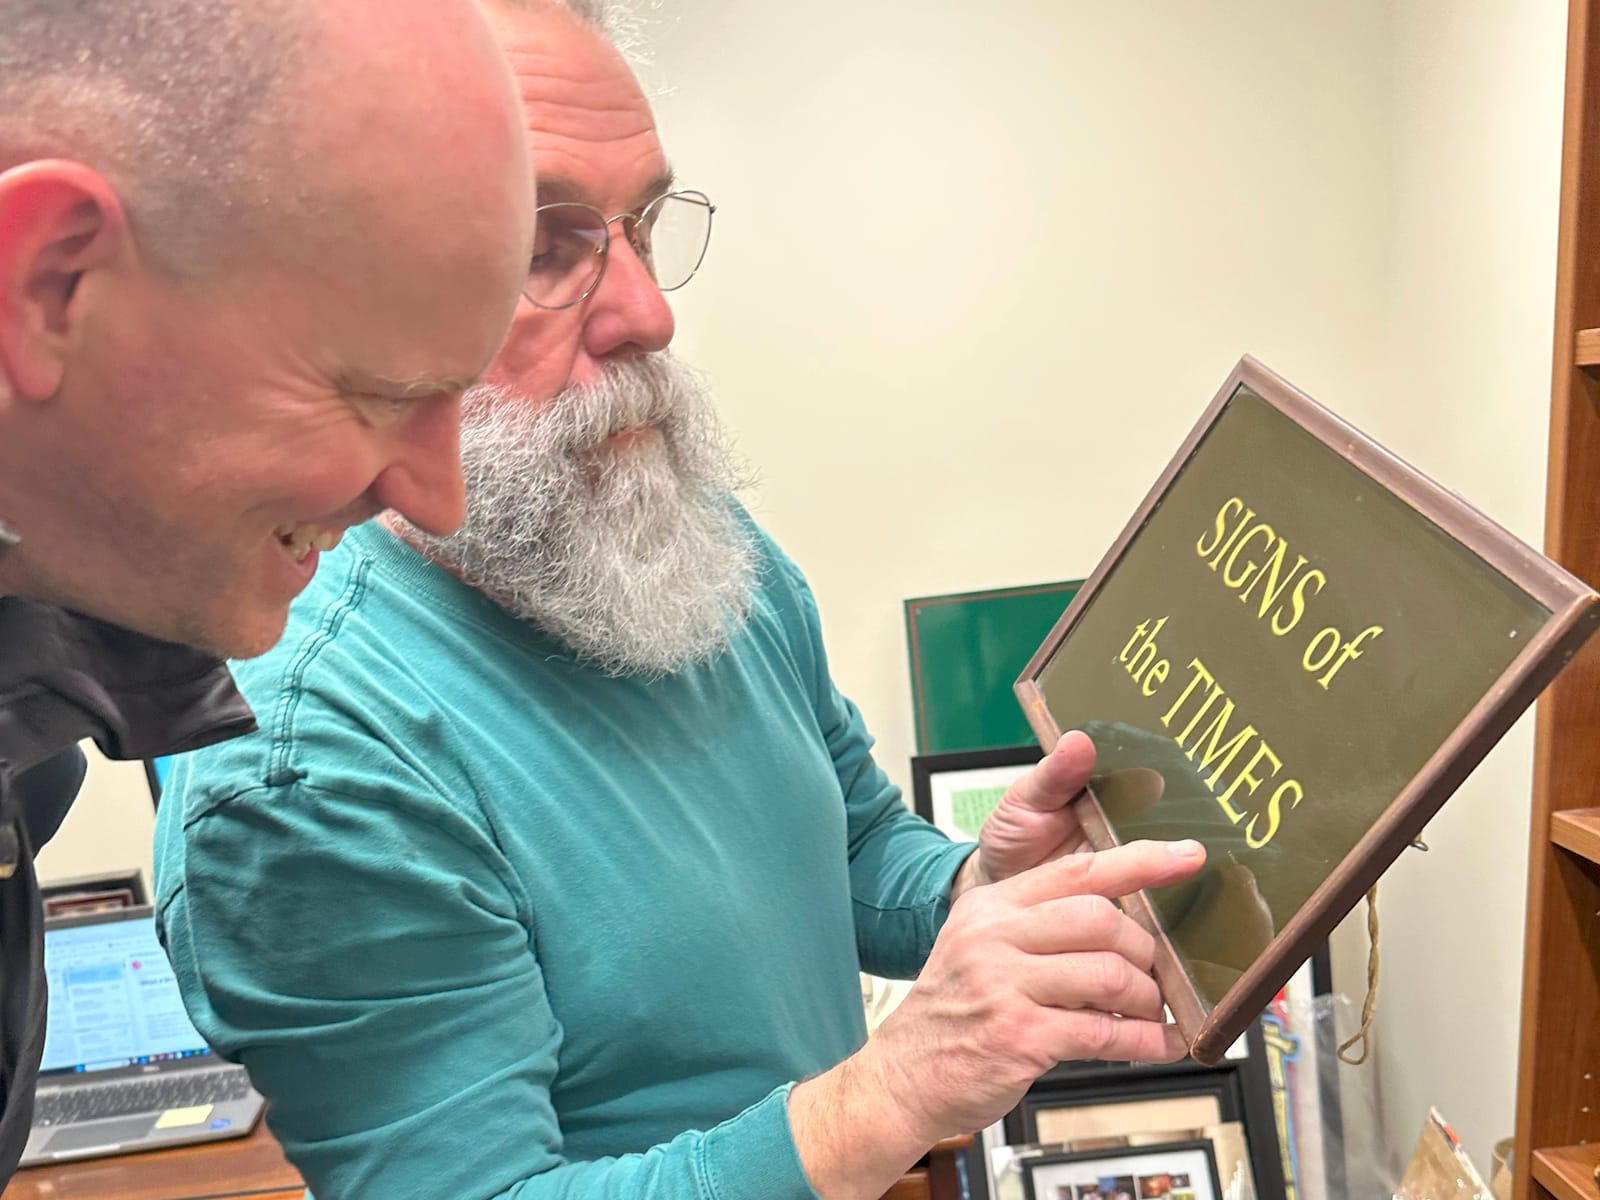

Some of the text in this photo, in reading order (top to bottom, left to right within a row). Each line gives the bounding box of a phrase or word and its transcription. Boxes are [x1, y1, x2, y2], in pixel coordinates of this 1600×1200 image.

[1196, 497, 1384, 690] SIGNS of
[1119, 615, 1304, 849] the TIMES
